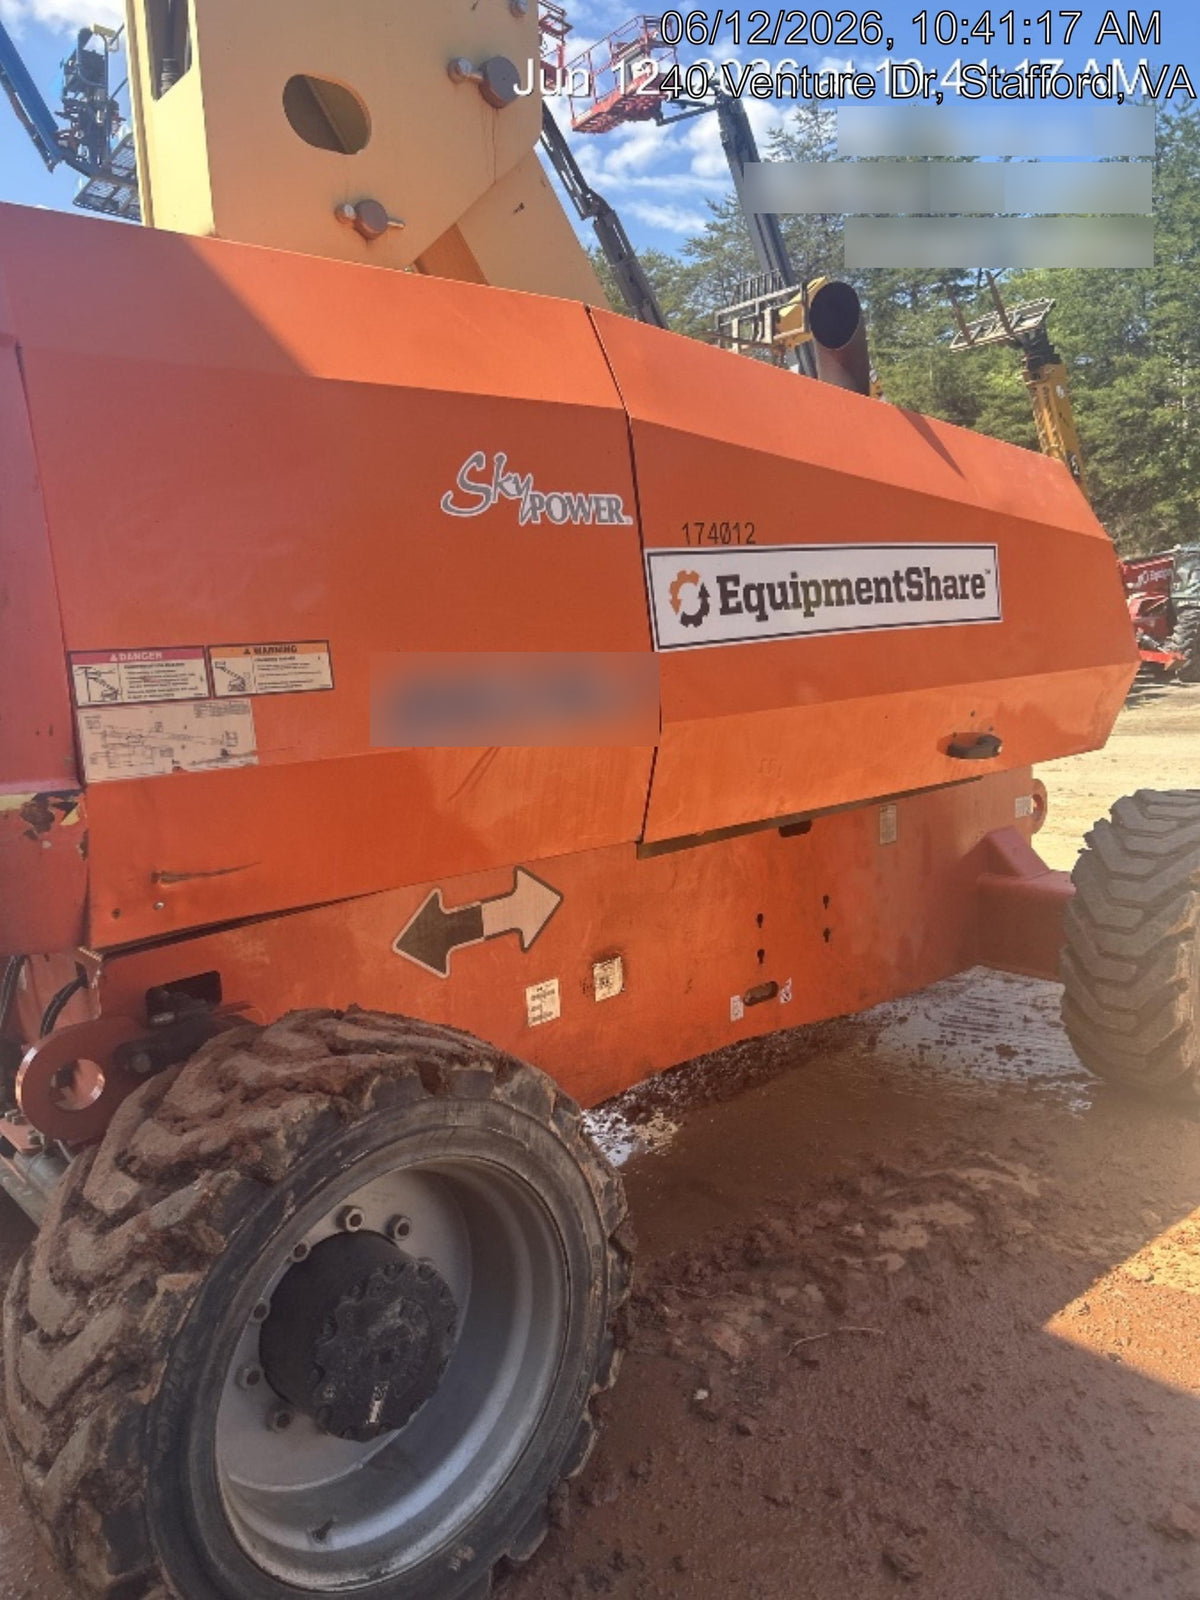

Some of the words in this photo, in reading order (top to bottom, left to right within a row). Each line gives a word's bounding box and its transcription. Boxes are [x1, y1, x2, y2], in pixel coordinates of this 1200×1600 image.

[682, 521, 756, 545] 174012
[715, 566, 987, 621] EquipmentShare
[118, 651, 163, 661] DANGER
